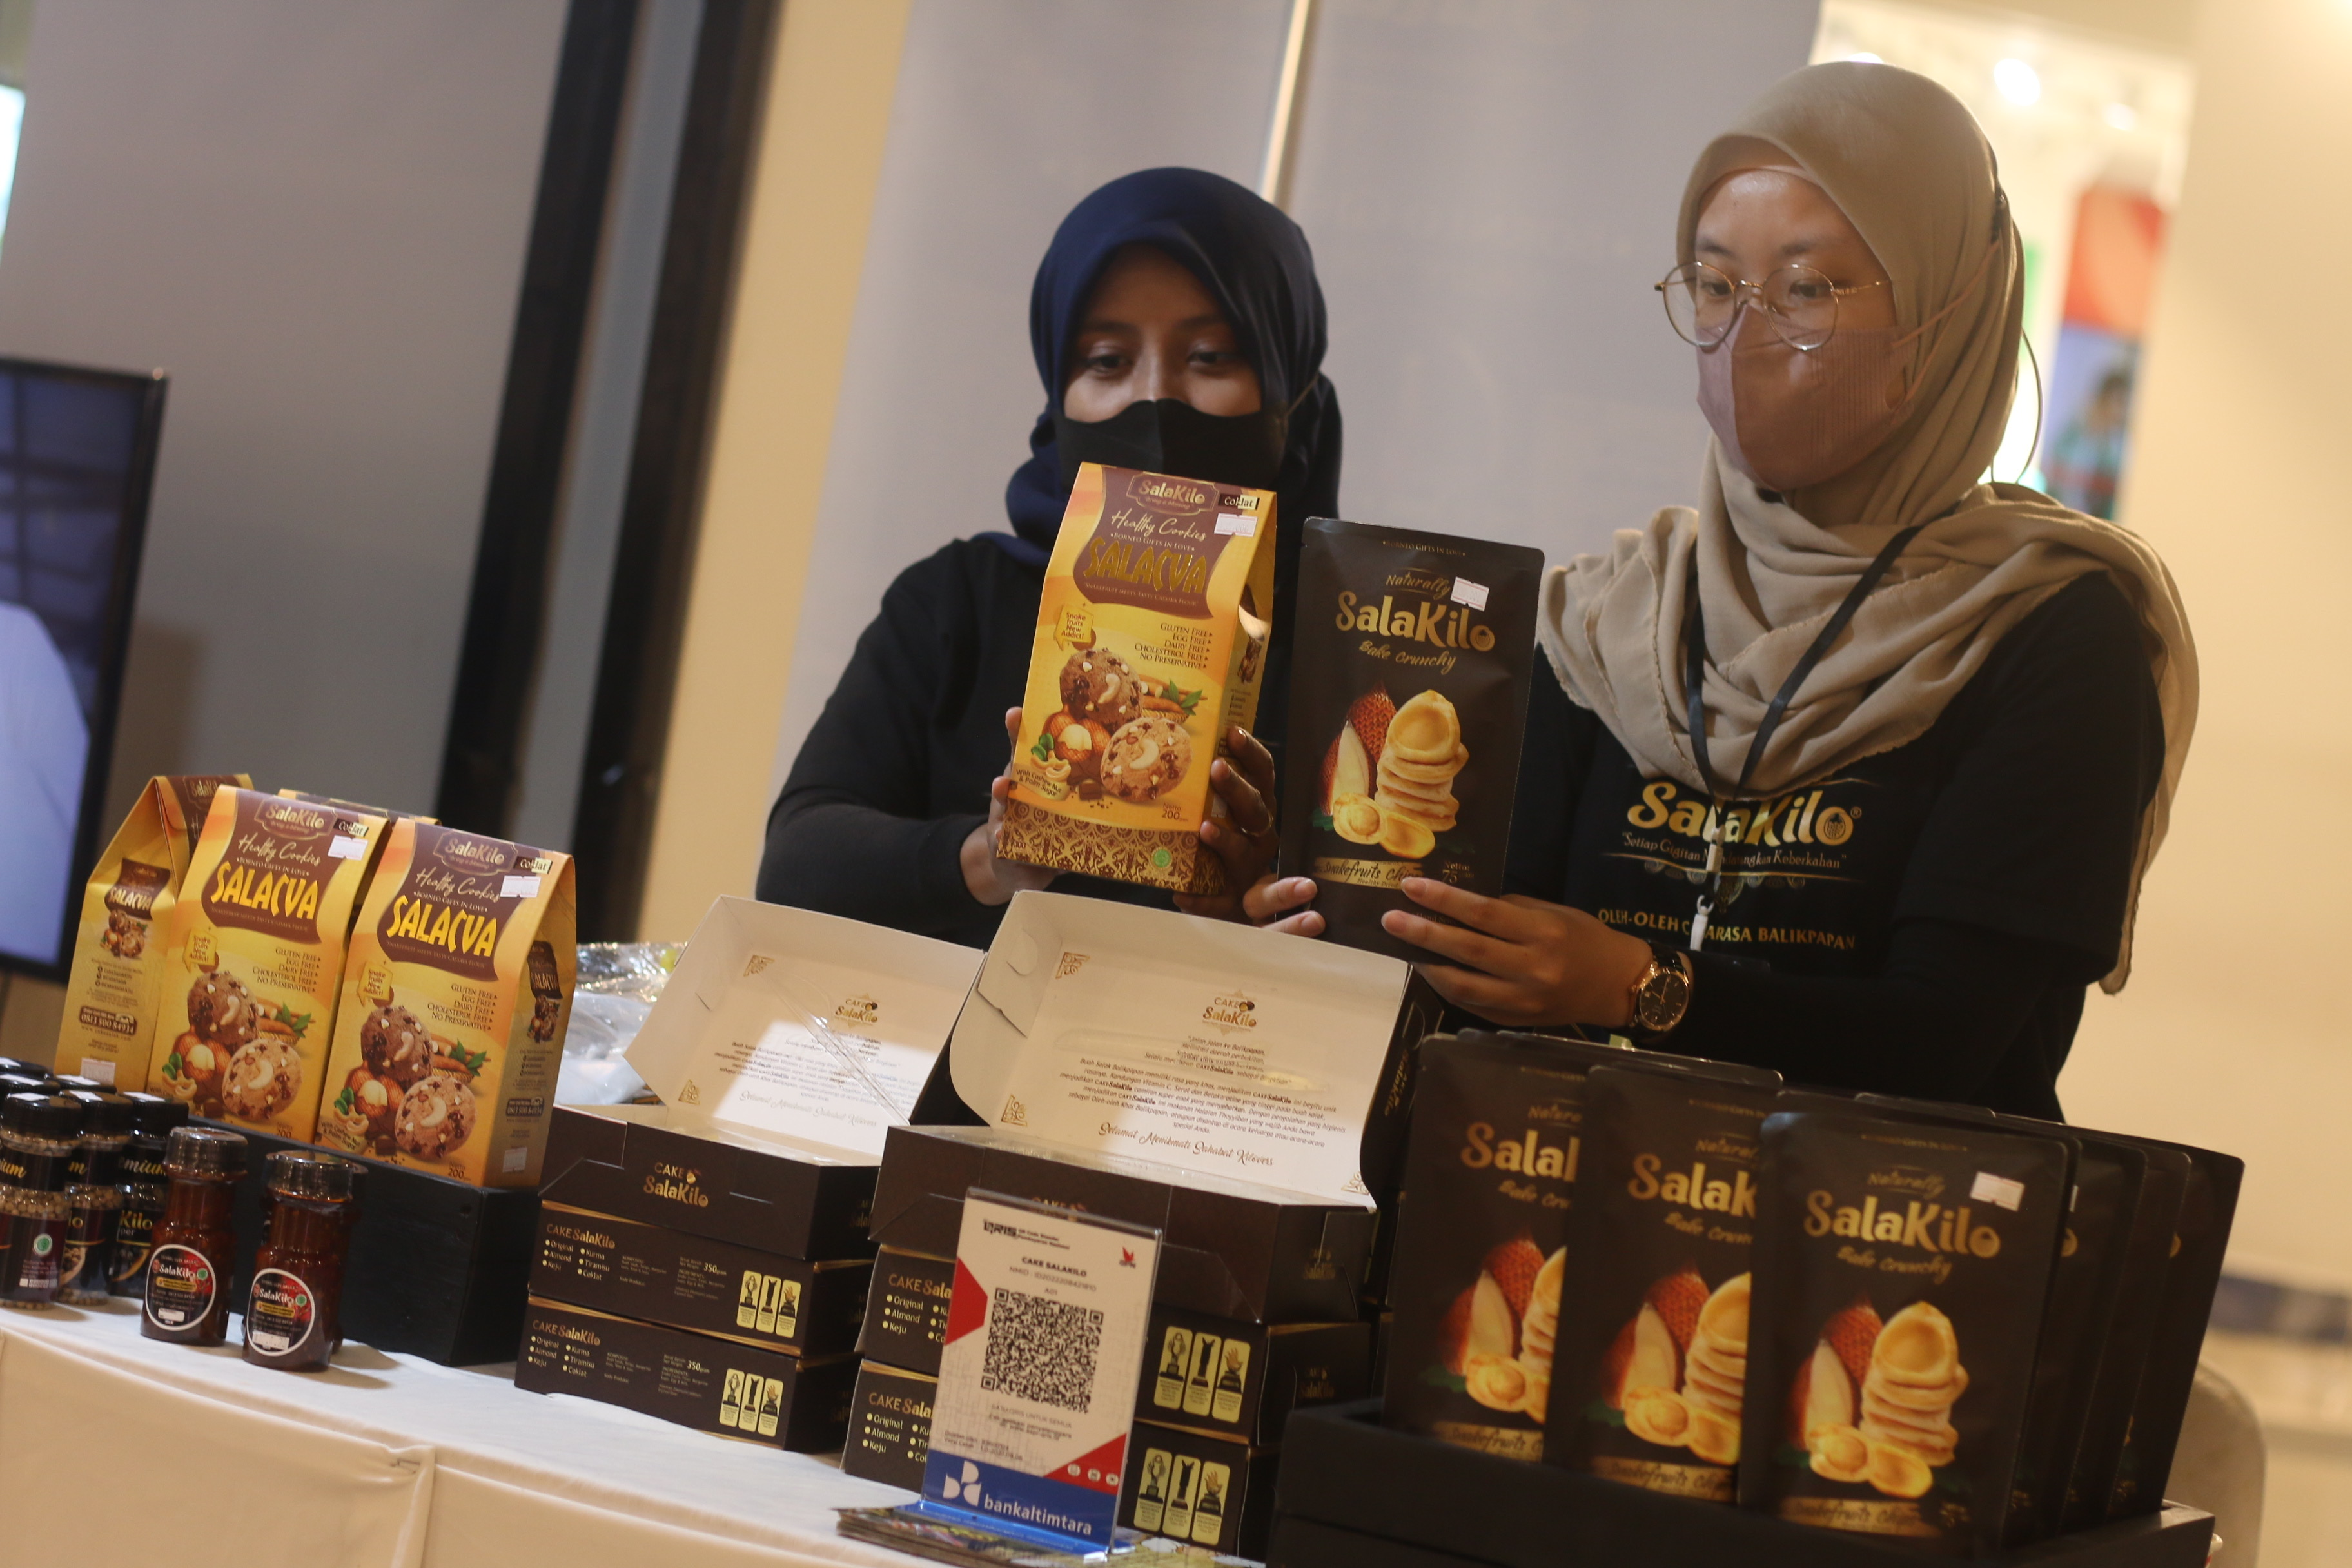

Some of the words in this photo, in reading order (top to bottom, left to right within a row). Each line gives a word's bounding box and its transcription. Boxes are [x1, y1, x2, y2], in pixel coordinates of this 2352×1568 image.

[1140, 479, 1206, 505] SalaKilo
[1224, 495, 1254, 508] Coklat
[1111, 508, 1155, 537] Healthy
[1159, 517, 1206, 542] Cookies
[1114, 533, 1142, 543] BORNEO
[1144, 537, 1162, 547] GIFTS
[1174, 542, 1191, 551] LOVE
[1386, 571, 1451, 600] Naturally
[1066, 612, 1086, 621] Snake
[1066, 618, 1083, 627] fruits
[1335, 590, 1496, 652] SalaKilo
[1161, 622, 1190, 634] GLUTEN
[1191, 627, 1207, 638] FREE
[1173, 633, 1188, 642] EGG
[1190, 636, 1206, 645] FREE
[1135, 642, 1184, 658] CHOLESTEROL
[1187, 652, 1203, 662] FREE
[1164, 640, 1187, 650] DAIRY
[1188, 643, 1204, 654] FREE
[1359, 640, 1391, 660] Bake
[1395, 650, 1456, 675] Crunchy
[1139, 652, 1153, 661] NO
[1154, 654, 1201, 670] PRESERVATIVE
[1016, 769, 1031, 777] With
[1052, 783, 1062, 793] Nut
[1025, 776, 1041, 788] Palm
[265, 805, 325, 830] SalaKilo
[1162, 810, 1181, 821] 200
[238, 832, 277, 863] Healthy
[279, 841, 321, 867] Cookies
[444, 838, 505, 865] SalaKilo
[1660, 839, 1701, 861] Gigitan
[415, 866, 455, 897] Healthy
[457, 876, 501, 903] Cookies
[1598, 908, 1679, 932] OLEH-OLEH
[1683, 921, 1752, 942] CARASA
[1758, 927, 1856, 950] BALIKPAPAN
[275, 946, 301, 959] GLUTEN
[302, 951, 317, 962] FREE
[286, 957, 300, 967] EGG
[301, 960, 315, 969] FREE
[252, 966, 296, 983] CHOLESTEROL
[298, 975, 313, 985] FREE
[279, 963, 297, 974] DAIRY
[300, 967, 314, 977] FREE
[257, 975, 269, 985] NO
[270, 977, 311, 993] PRESERVATIVE
[451, 983, 476, 996] GLUTEN
[478, 988, 493, 999] FREE
[454, 1000, 473, 1011] DAIRY
[475, 1005, 490, 1015] FREE
[462, 994, 475, 1004] EGG
[477, 997, 492, 1008] FREE
[1214, 997, 1239, 1009] CAKE
[427, 1002, 471, 1019] CHOLESTEROL
[473, 1013, 489, 1024] FREE
[432, 1011, 444, 1021] NO
[444, 1015, 487, 1032] PRESERVATIVE
[835, 1006, 879, 1023] SalaKilo
[1202, 1006, 1257, 1028] SalaKilo
[1098, 1121, 1139, 1139] Selamat
[1139, 1132, 1191, 1150] Menikmati
[1192, 1141, 1234, 1159] Sahabat
[448, 1168, 464, 1179] 200
[654, 1161, 685, 1179] CAKE
[643, 1174, 709, 1208] SalaKilo
[1627, 1153, 1758, 1219] SalaK
[1803, 1190, 2001, 1259] SalaKilo
[547, 1224, 573, 1237] CAKE
[573, 1228, 616, 1250] SalaKilo
[550, 1239, 574, 1253] Original
[585, 1249, 605, 1260] Kurma
[547, 1260, 562, 1272] Keju
[583, 1269, 602, 1281] Coklat
[549, 1251, 572, 1262] Almond
[585, 1259, 610, 1273] Tiramisu
[1021, 1256, 1044, 1268] CAKE
[1045, 1261, 1088, 1277] SALAKILO
[888, 1273, 922, 1293] CAKE
[922, 1279, 952, 1300] Sala
[894, 1295, 924, 1310] Original
[891, 1308, 921, 1324] Almond
[532, 1319, 557, 1334] CAKE
[558, 1324, 601, 1346] SalaKilo
[889, 1321, 906, 1335] Keju
[536, 1335, 560, 1349] Original
[571, 1345, 591, 1357] Kurma
[533, 1357, 547, 1368] Keju
[568, 1366, 587, 1378] Coklat
[534, 1347, 558, 1359] Almond
[569, 1355, 595, 1369] Tiramisu
[868, 1391, 902, 1411] CAKE
[901, 1397, 932, 1418] Sala
[874, 1413, 903, 1429] Original
[871, 1427, 900, 1443] Almond
[869, 1440, 887, 1454] Keju
[984, 1493, 1092, 1536] bankaltimtara
